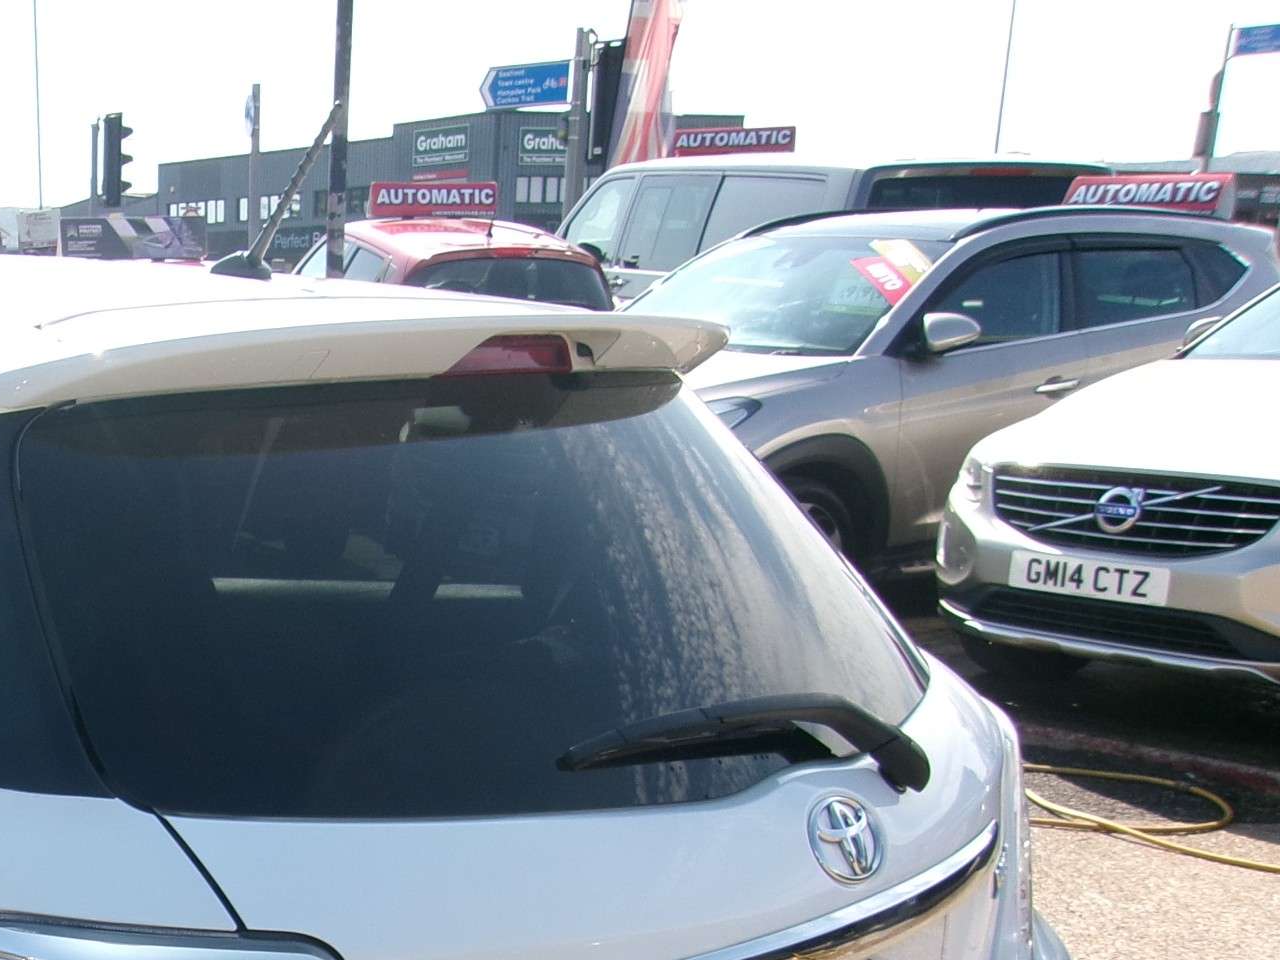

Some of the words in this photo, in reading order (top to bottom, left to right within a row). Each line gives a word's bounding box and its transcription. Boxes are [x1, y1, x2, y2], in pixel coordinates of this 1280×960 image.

[417, 133, 465, 151] Graham
[524, 134, 565, 150] Grah
[676, 130, 791, 147] AUTOMATIC
[377, 188, 494, 204] AUTOMATIC
[1071, 181, 1220, 203] AUTOMATIC
[1026, 558, 1084, 589] GM14
[1093, 566, 1152, 598] CTZ
